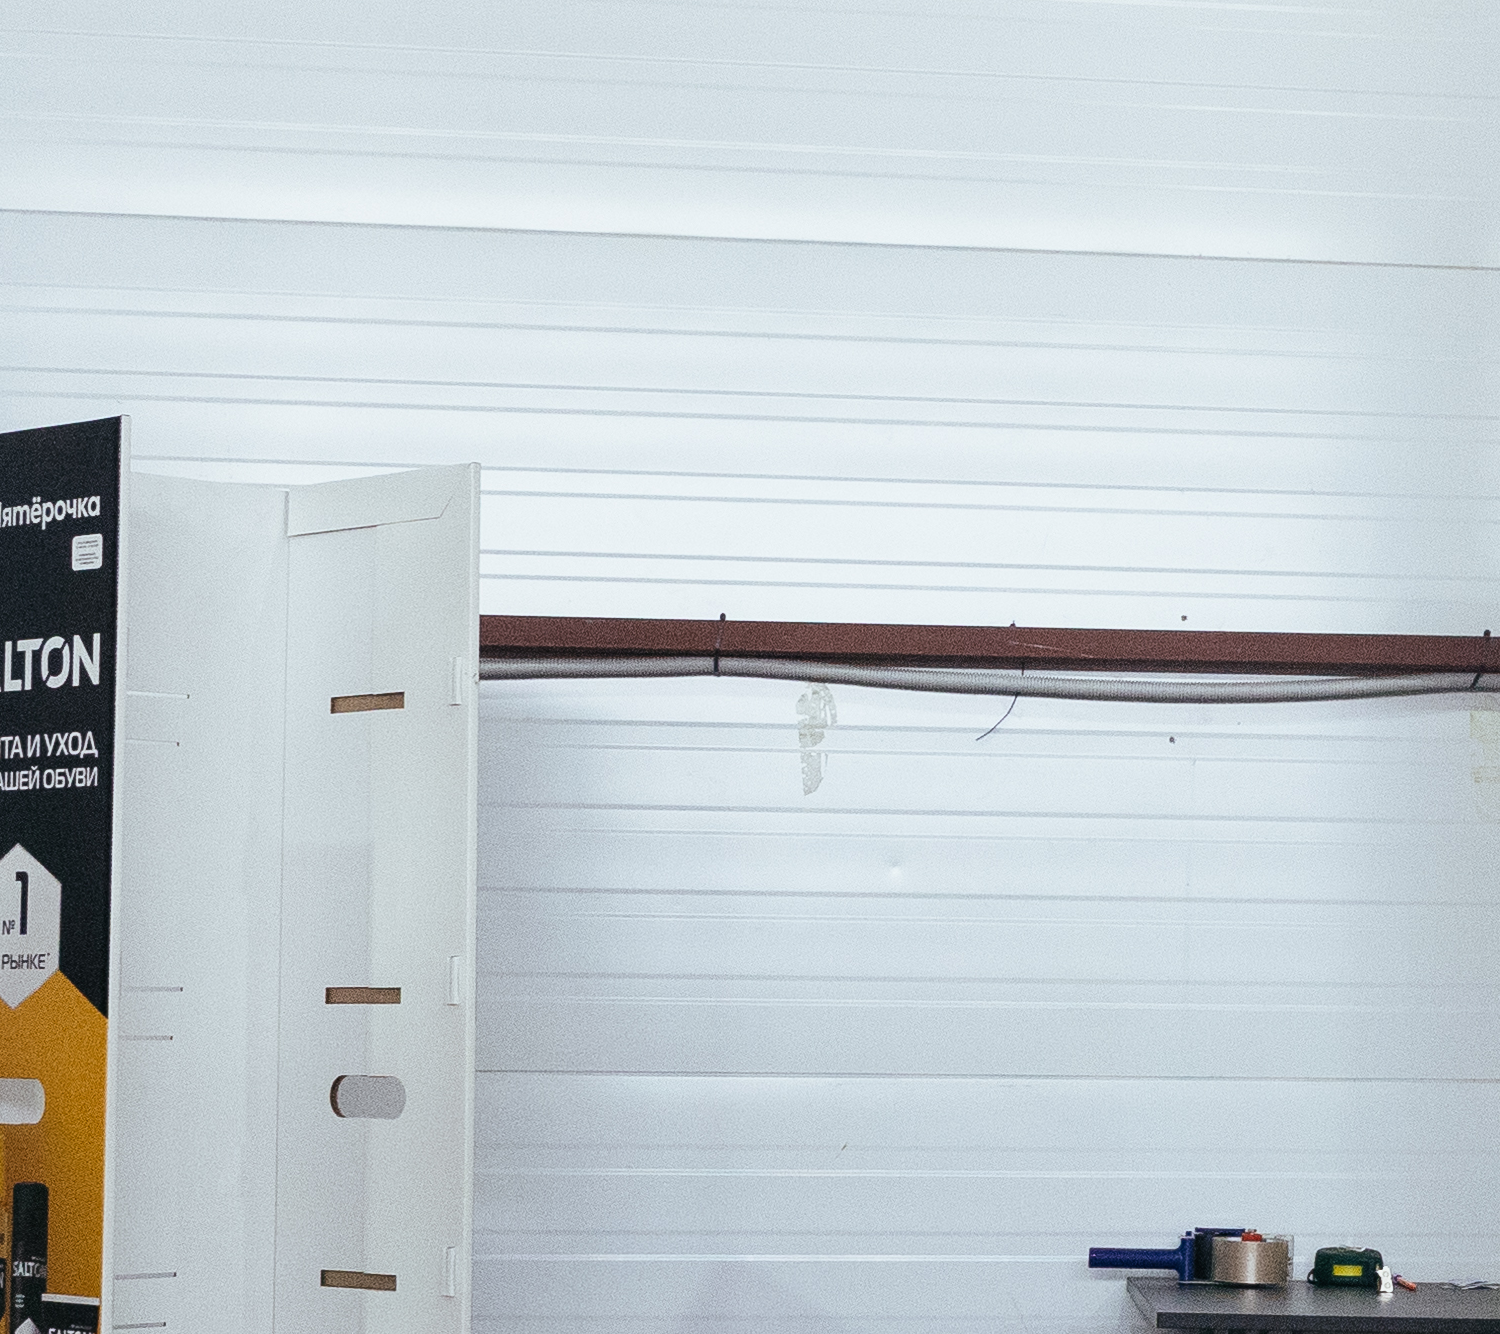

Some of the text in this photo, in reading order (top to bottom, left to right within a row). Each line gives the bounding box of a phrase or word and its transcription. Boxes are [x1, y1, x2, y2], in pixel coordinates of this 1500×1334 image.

[26, 734, 41, 758] И
[44, 731, 99, 758] УХОД
[43, 766, 99, 790] ОБУВИ
